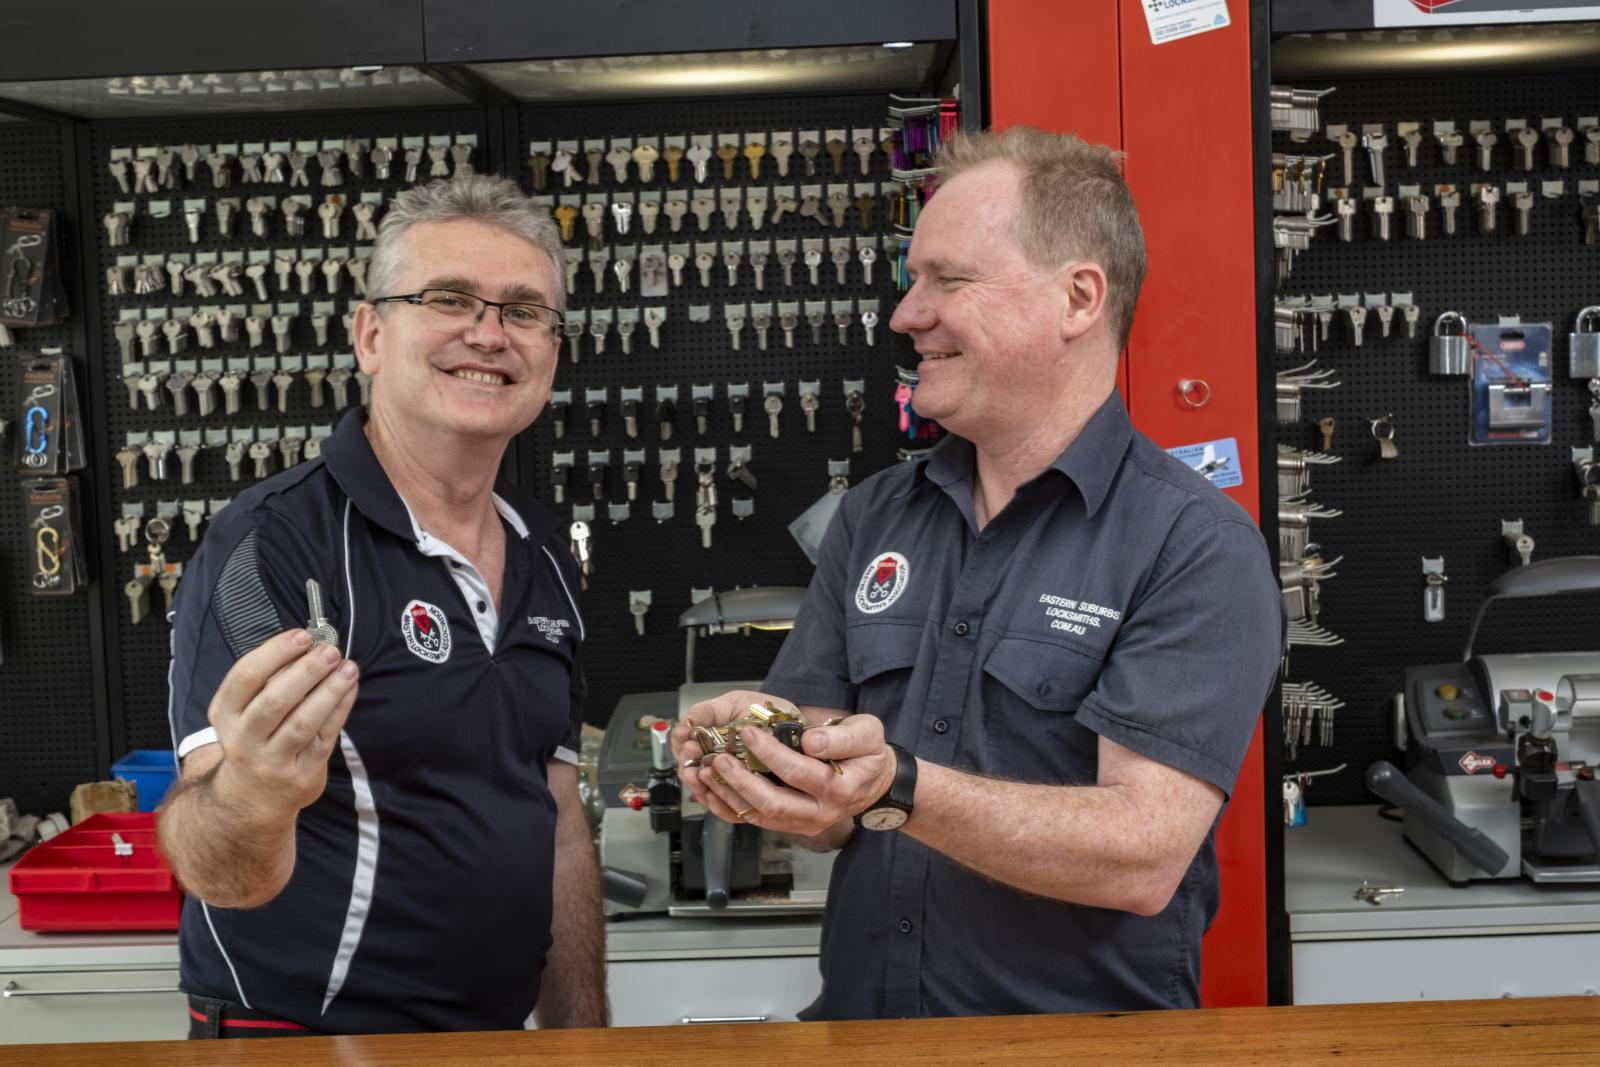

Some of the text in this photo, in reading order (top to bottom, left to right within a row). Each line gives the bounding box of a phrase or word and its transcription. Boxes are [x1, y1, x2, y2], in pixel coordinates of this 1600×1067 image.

[1039, 593, 1121, 621] EASTERN SUBURBS
[403, 614, 416, 643] MASTER
[1050, 619, 1087, 635] COM.AU
